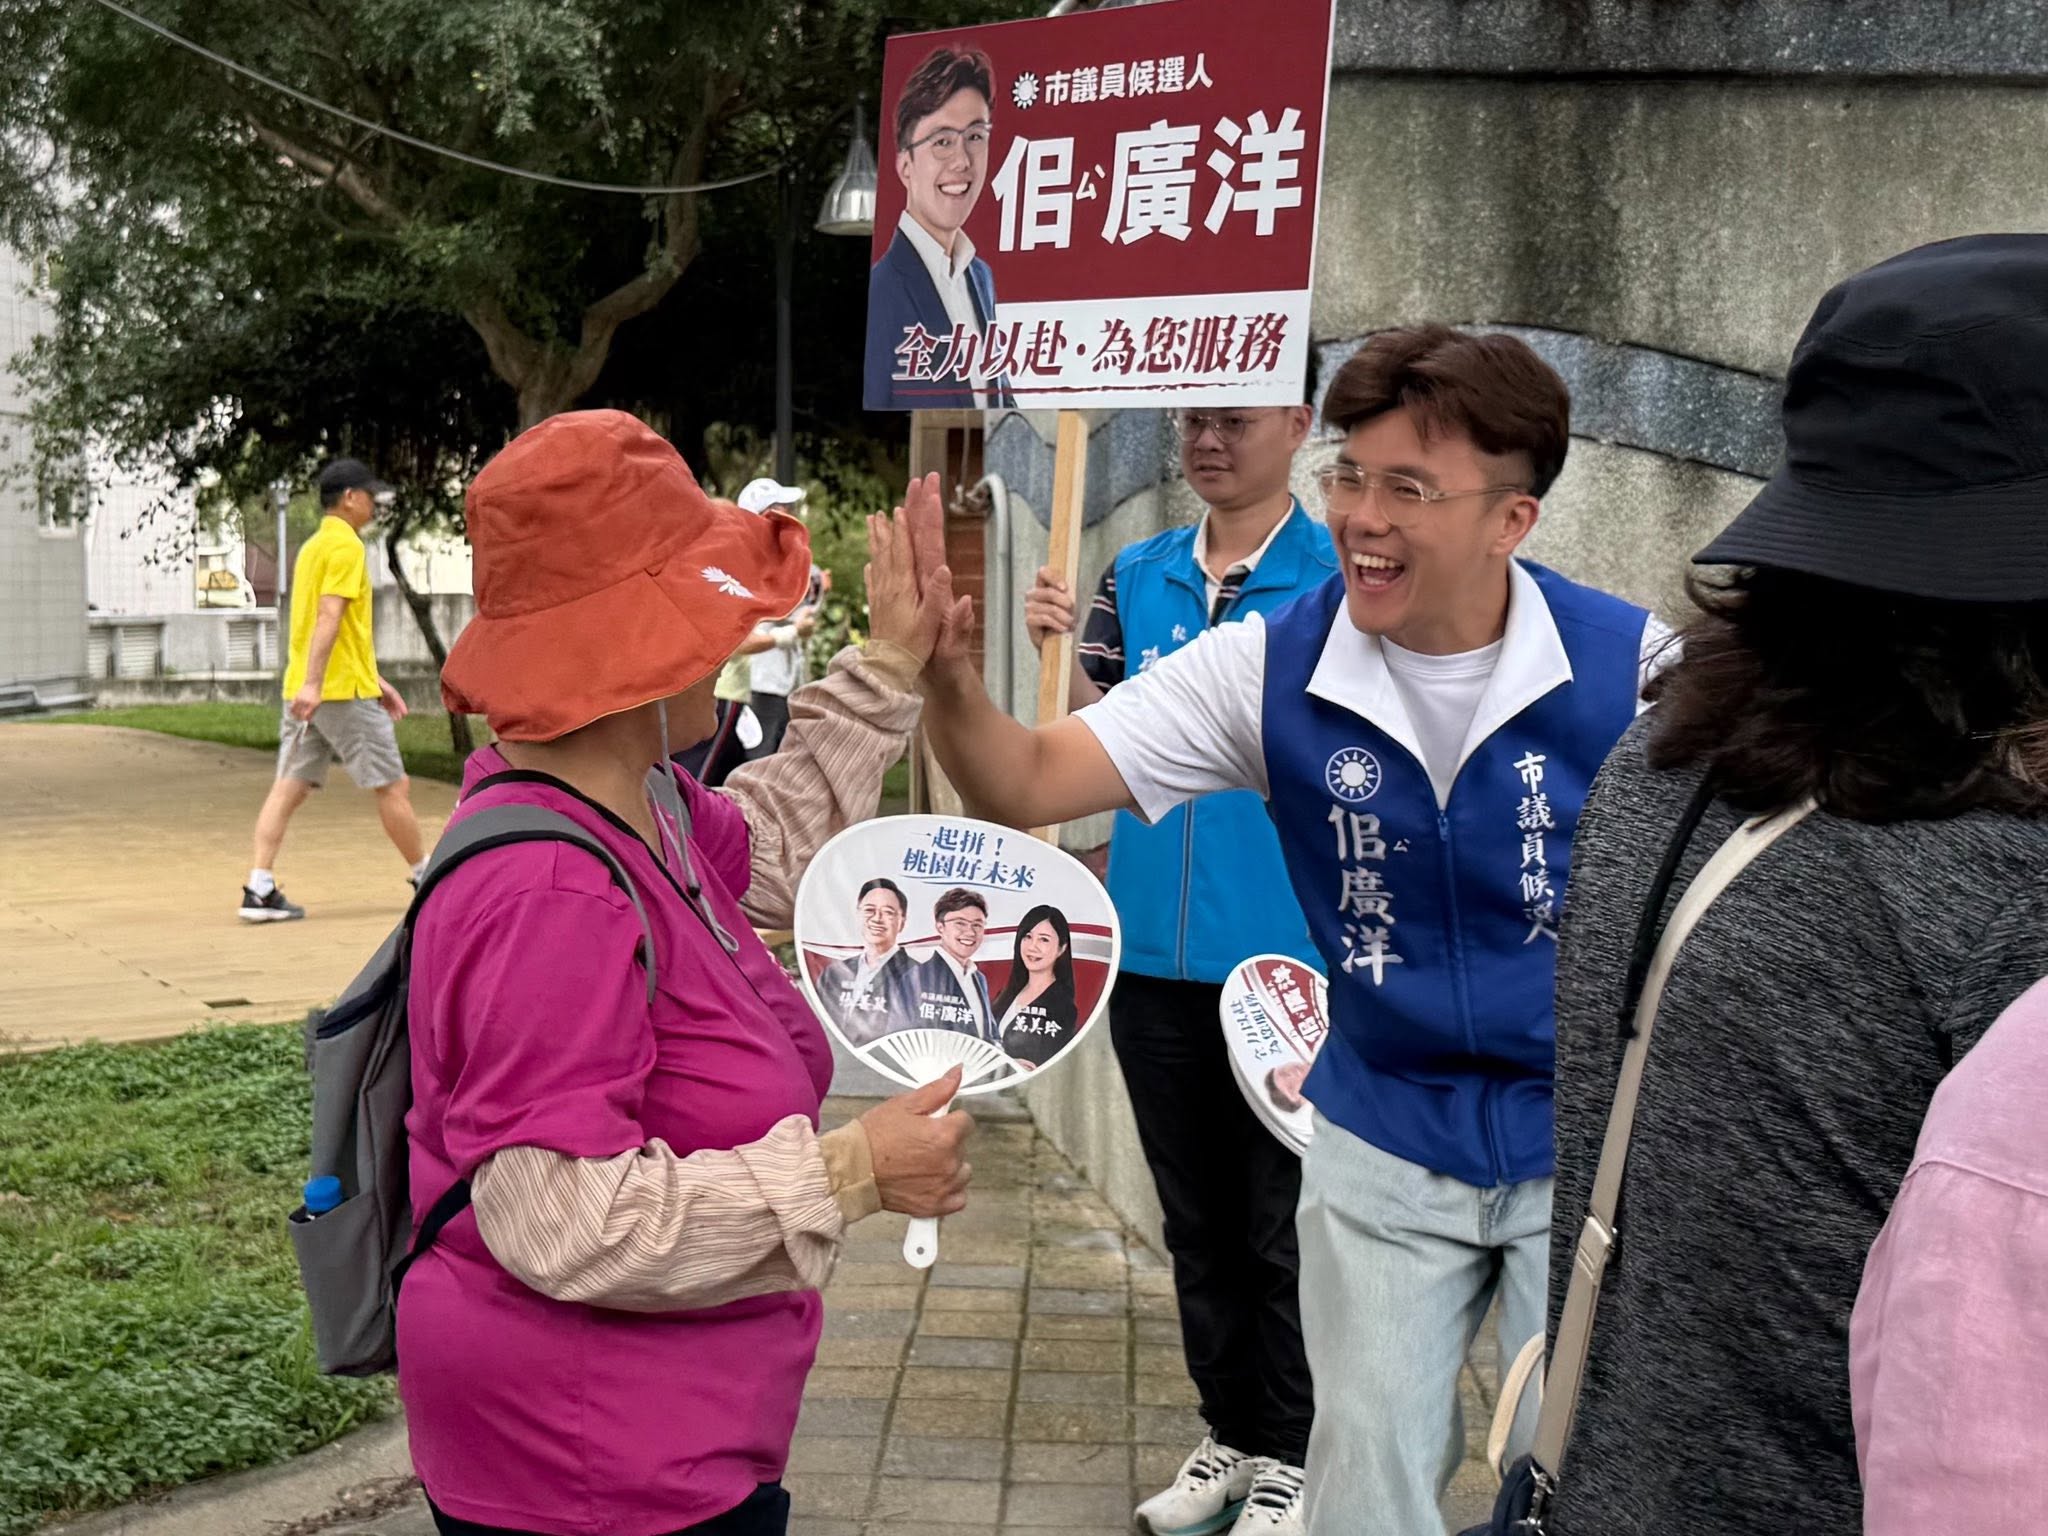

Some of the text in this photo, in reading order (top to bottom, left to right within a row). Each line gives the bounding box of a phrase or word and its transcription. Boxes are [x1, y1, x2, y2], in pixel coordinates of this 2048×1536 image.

[1045, 53, 1213, 106] 市議員候選人
[903, 848, 1036, 888] 桃園好未來
